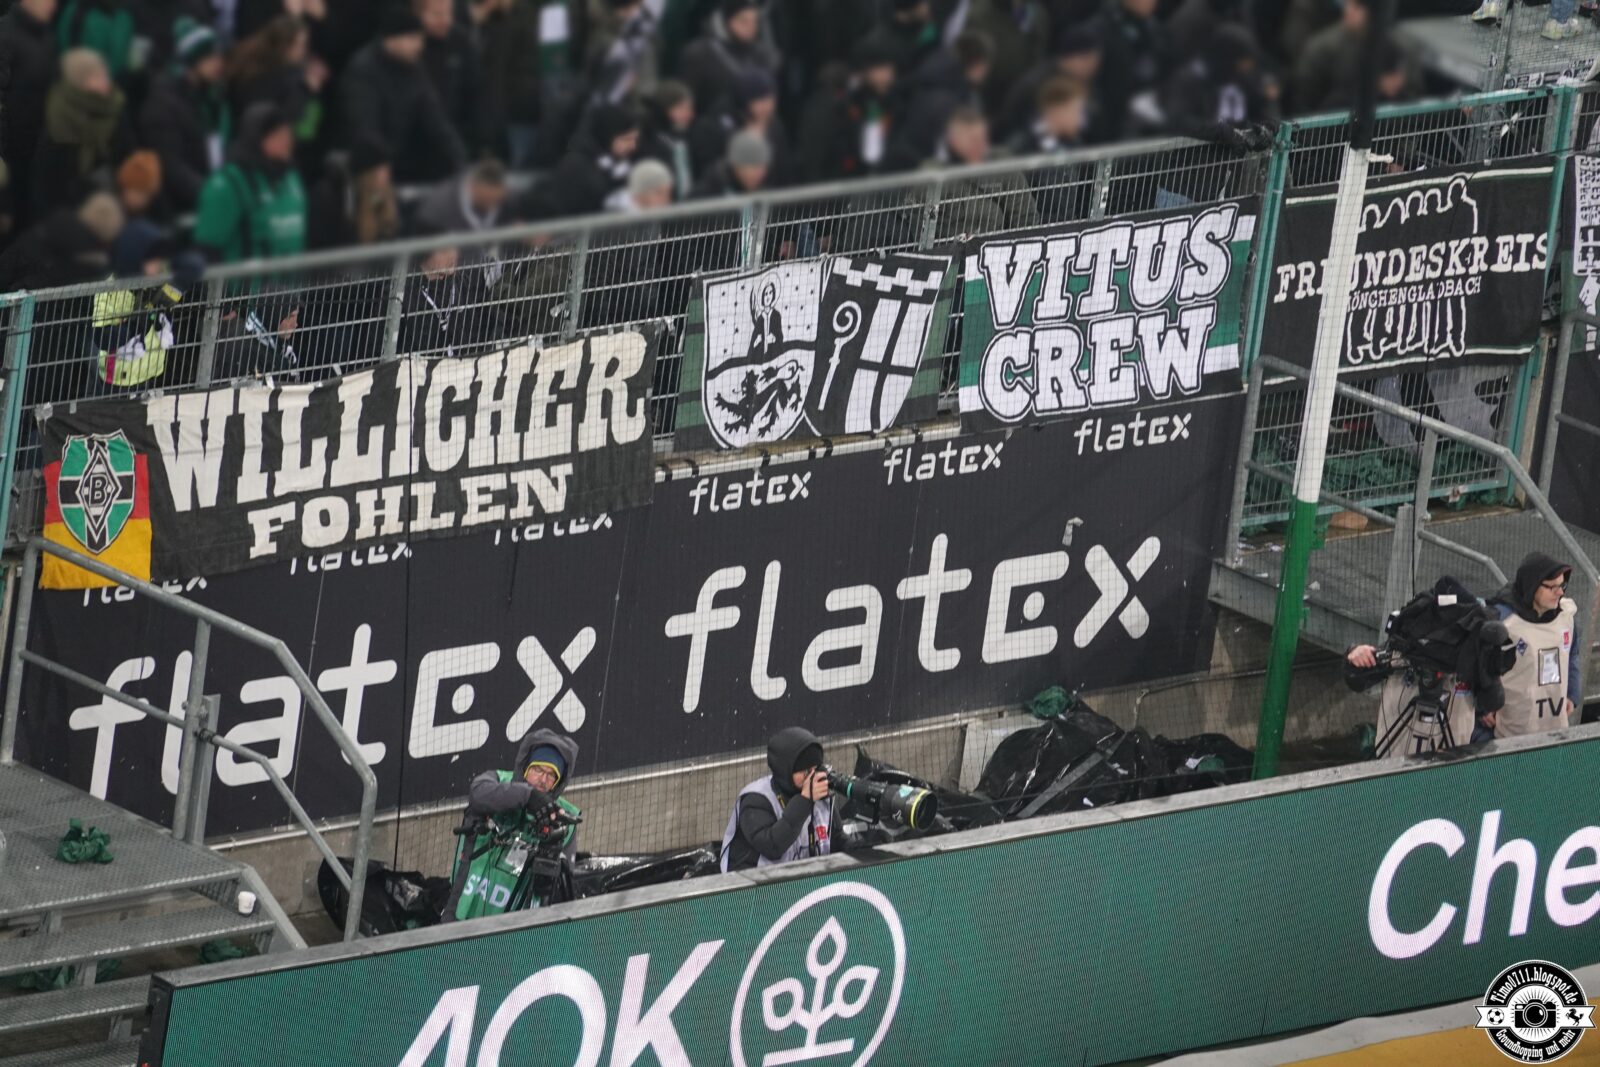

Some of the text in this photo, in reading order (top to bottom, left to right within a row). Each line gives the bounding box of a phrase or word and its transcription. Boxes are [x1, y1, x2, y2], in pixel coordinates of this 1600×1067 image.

[978, 203, 1239, 329] VITUS
[979, 301, 1216, 422] CREW
[146, 331, 647, 512] WILLICHER
[884, 439, 1004, 485] flatex
[1073, 412, 1192, 456] flatex
[248, 463, 573, 560] FOHLEN
[689, 469, 812, 515] flatex
[665, 532, 1161, 714] flatex
[1535, 696, 1564, 718] TV
[463, 873, 511, 908] SAD
[1368, 809, 1600, 960] Che
[396, 938, 726, 1067] AOK
